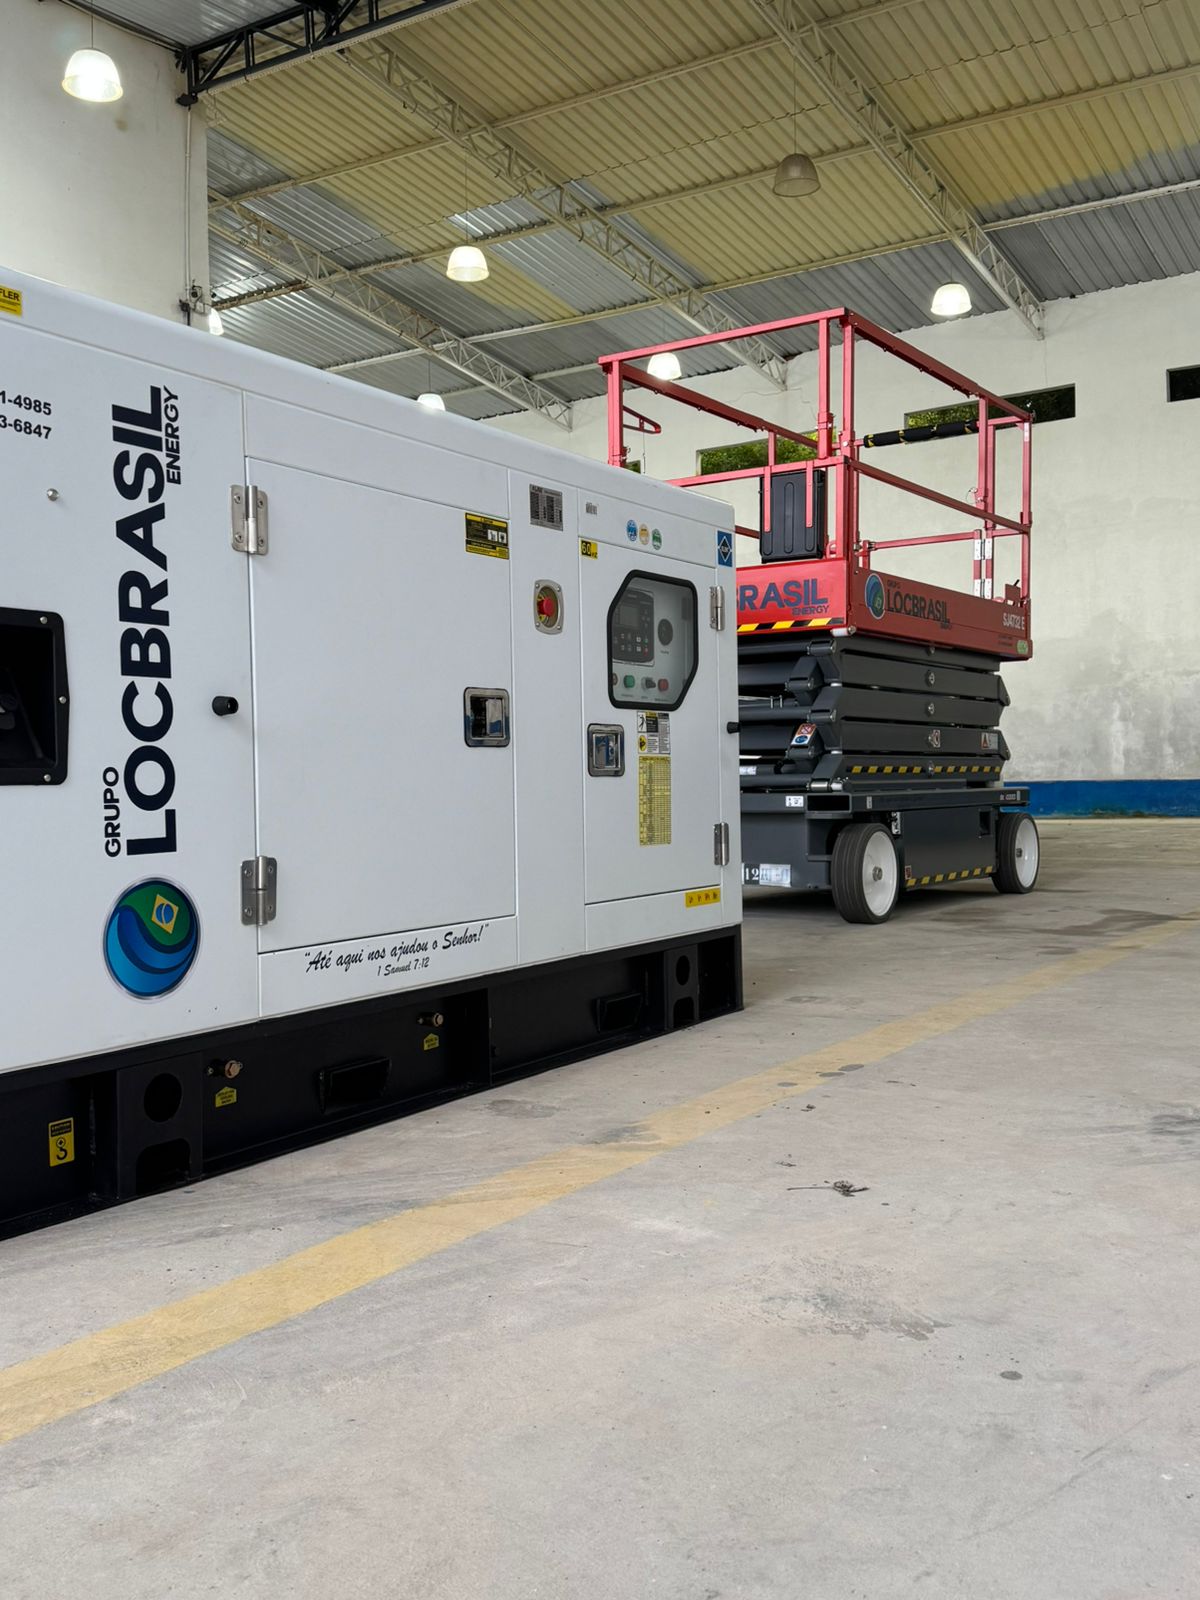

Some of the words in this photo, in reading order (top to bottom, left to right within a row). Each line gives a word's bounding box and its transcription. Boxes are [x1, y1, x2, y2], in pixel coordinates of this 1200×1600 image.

[0, 390, 52, 416] 1-4985
[0, 414, 52, 440] 3-6847
[163, 385, 182, 485] ENERGY
[736, 579, 828, 611] RASIL
[887, 589, 950, 623] LOCBRASIL
[112, 385, 177, 856] LOCBRASIL
[102, 766, 121, 857] GRUPO
[336, 949, 363, 972] aqui
[367, 946, 386, 961] nos
[390, 938, 429, 962] ajudou
[432, 940, 438, 951] o
[383, 959, 411, 976] Samuel
[413, 956, 430, 970] 7:12
